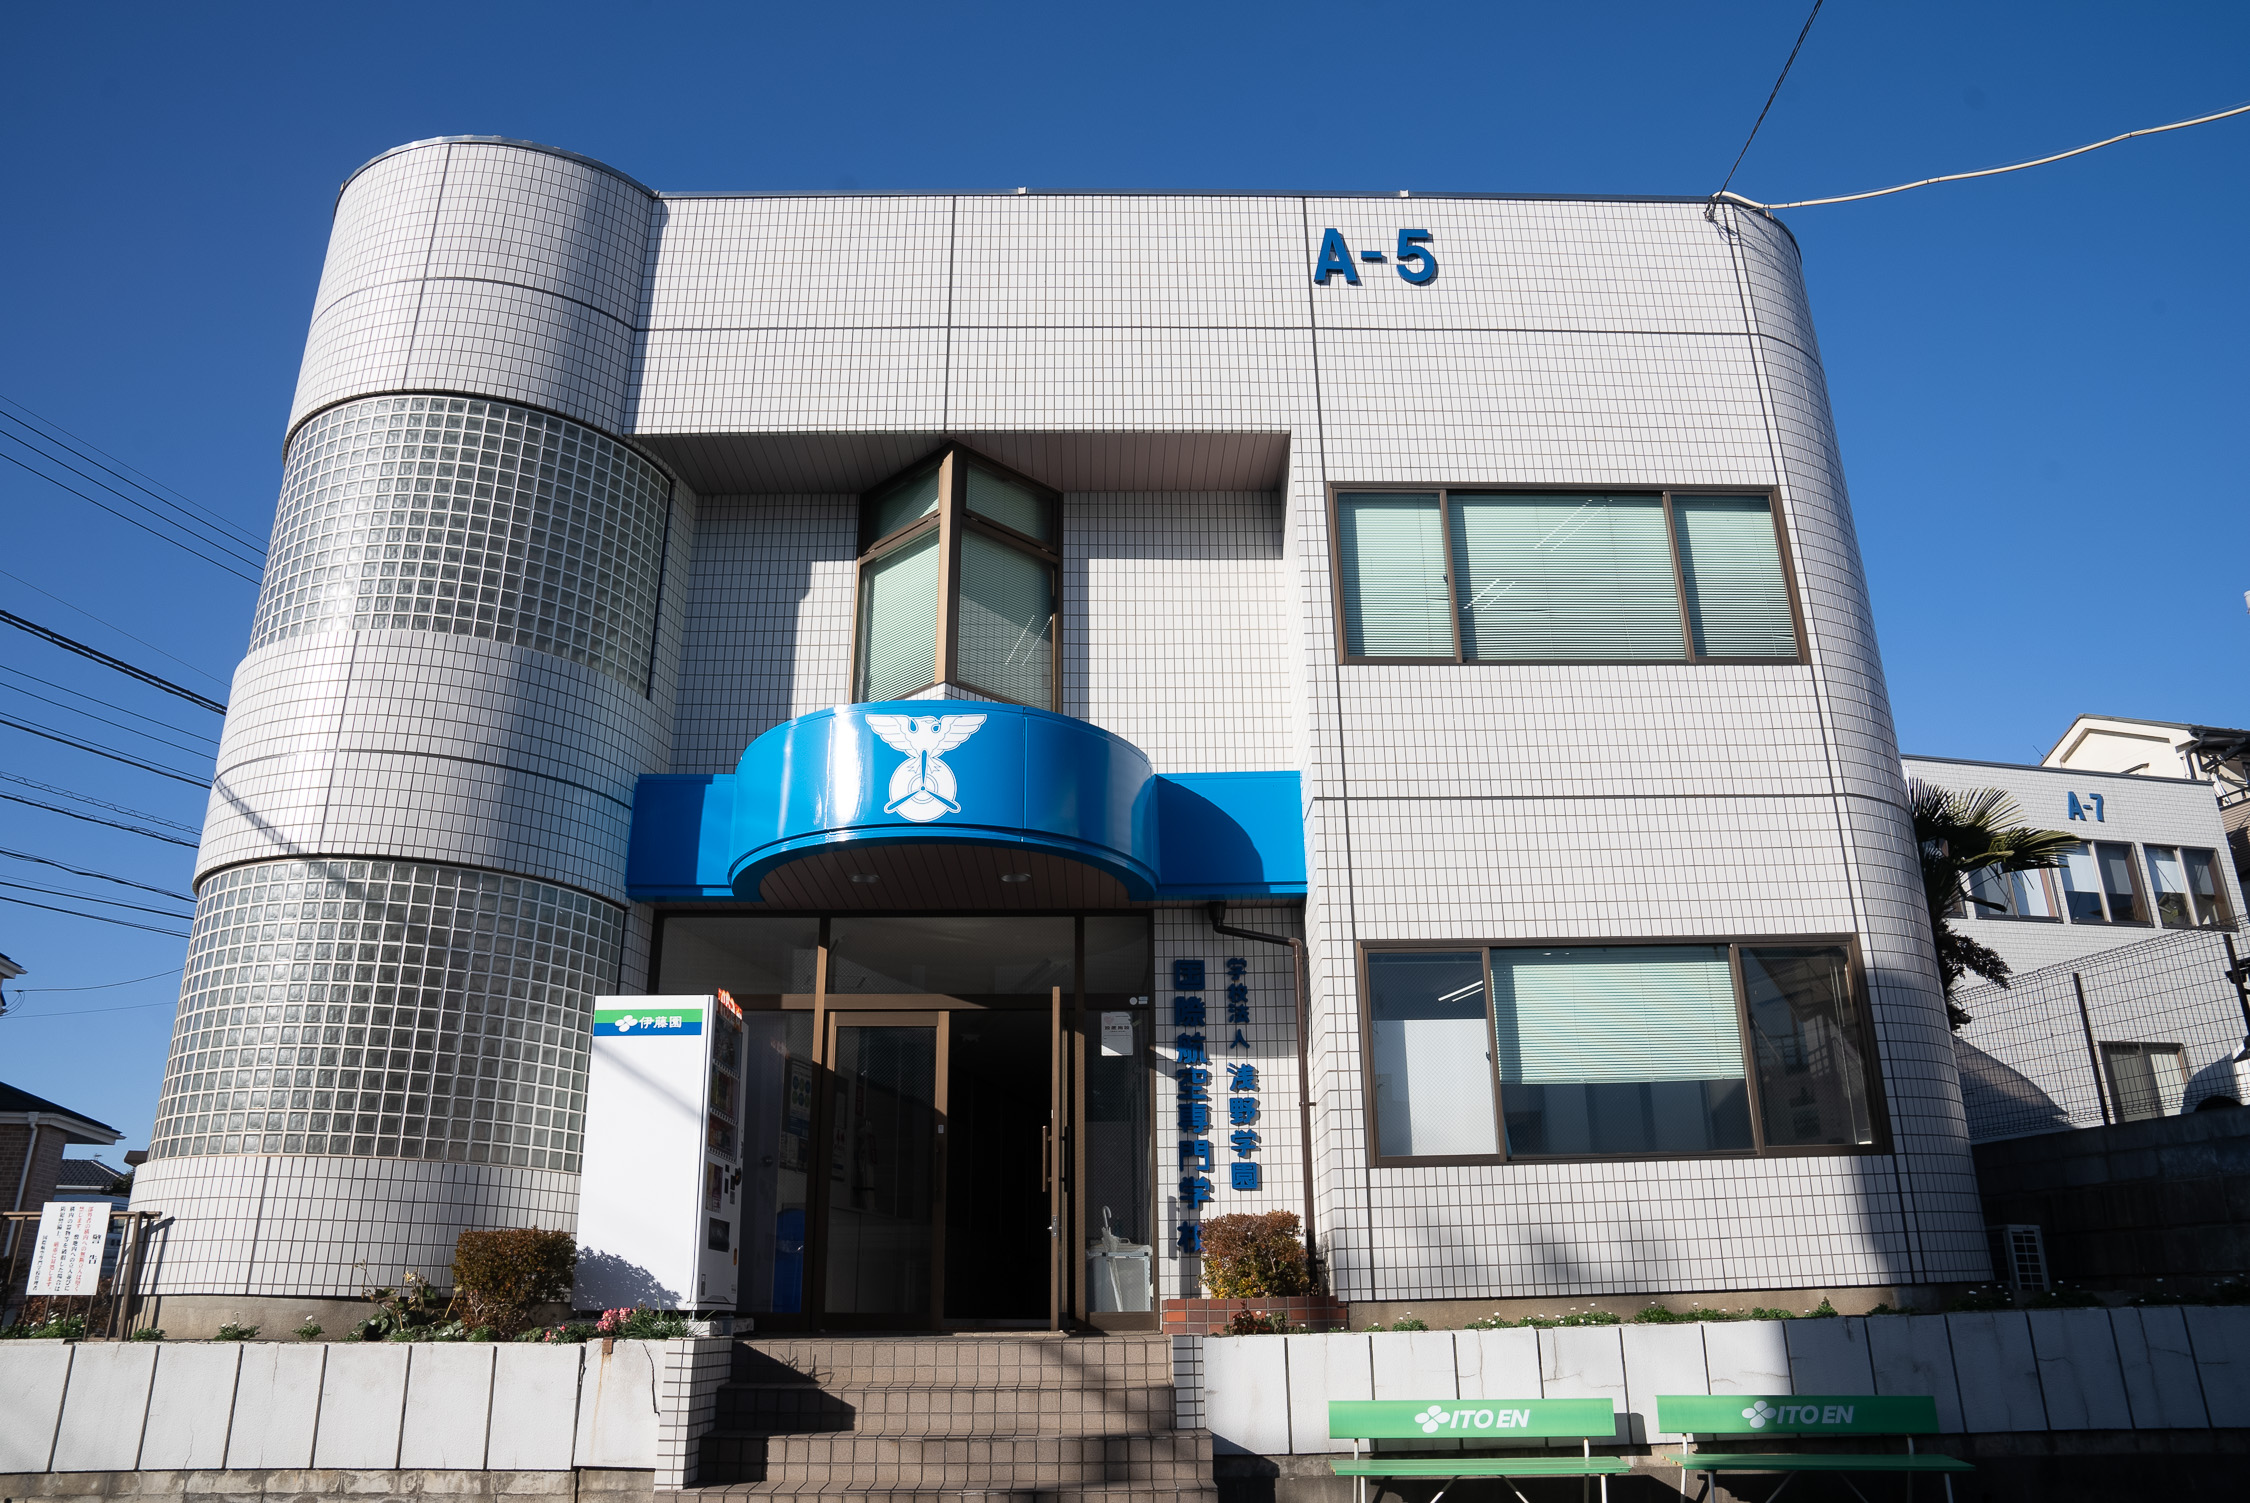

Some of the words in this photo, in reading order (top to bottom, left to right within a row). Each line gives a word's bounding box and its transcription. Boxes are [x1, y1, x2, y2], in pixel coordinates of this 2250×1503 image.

[1314, 228, 1436, 285] A-5
[2067, 791, 2105, 822] A-7
[639, 1015, 683, 1029] 伊藤園
[1450, 1409, 1494, 1429] ITO
[1496, 1409, 1530, 1428] EN
[1777, 1405, 1819, 1424] ITO
[1822, 1405, 1854, 1424] EN
